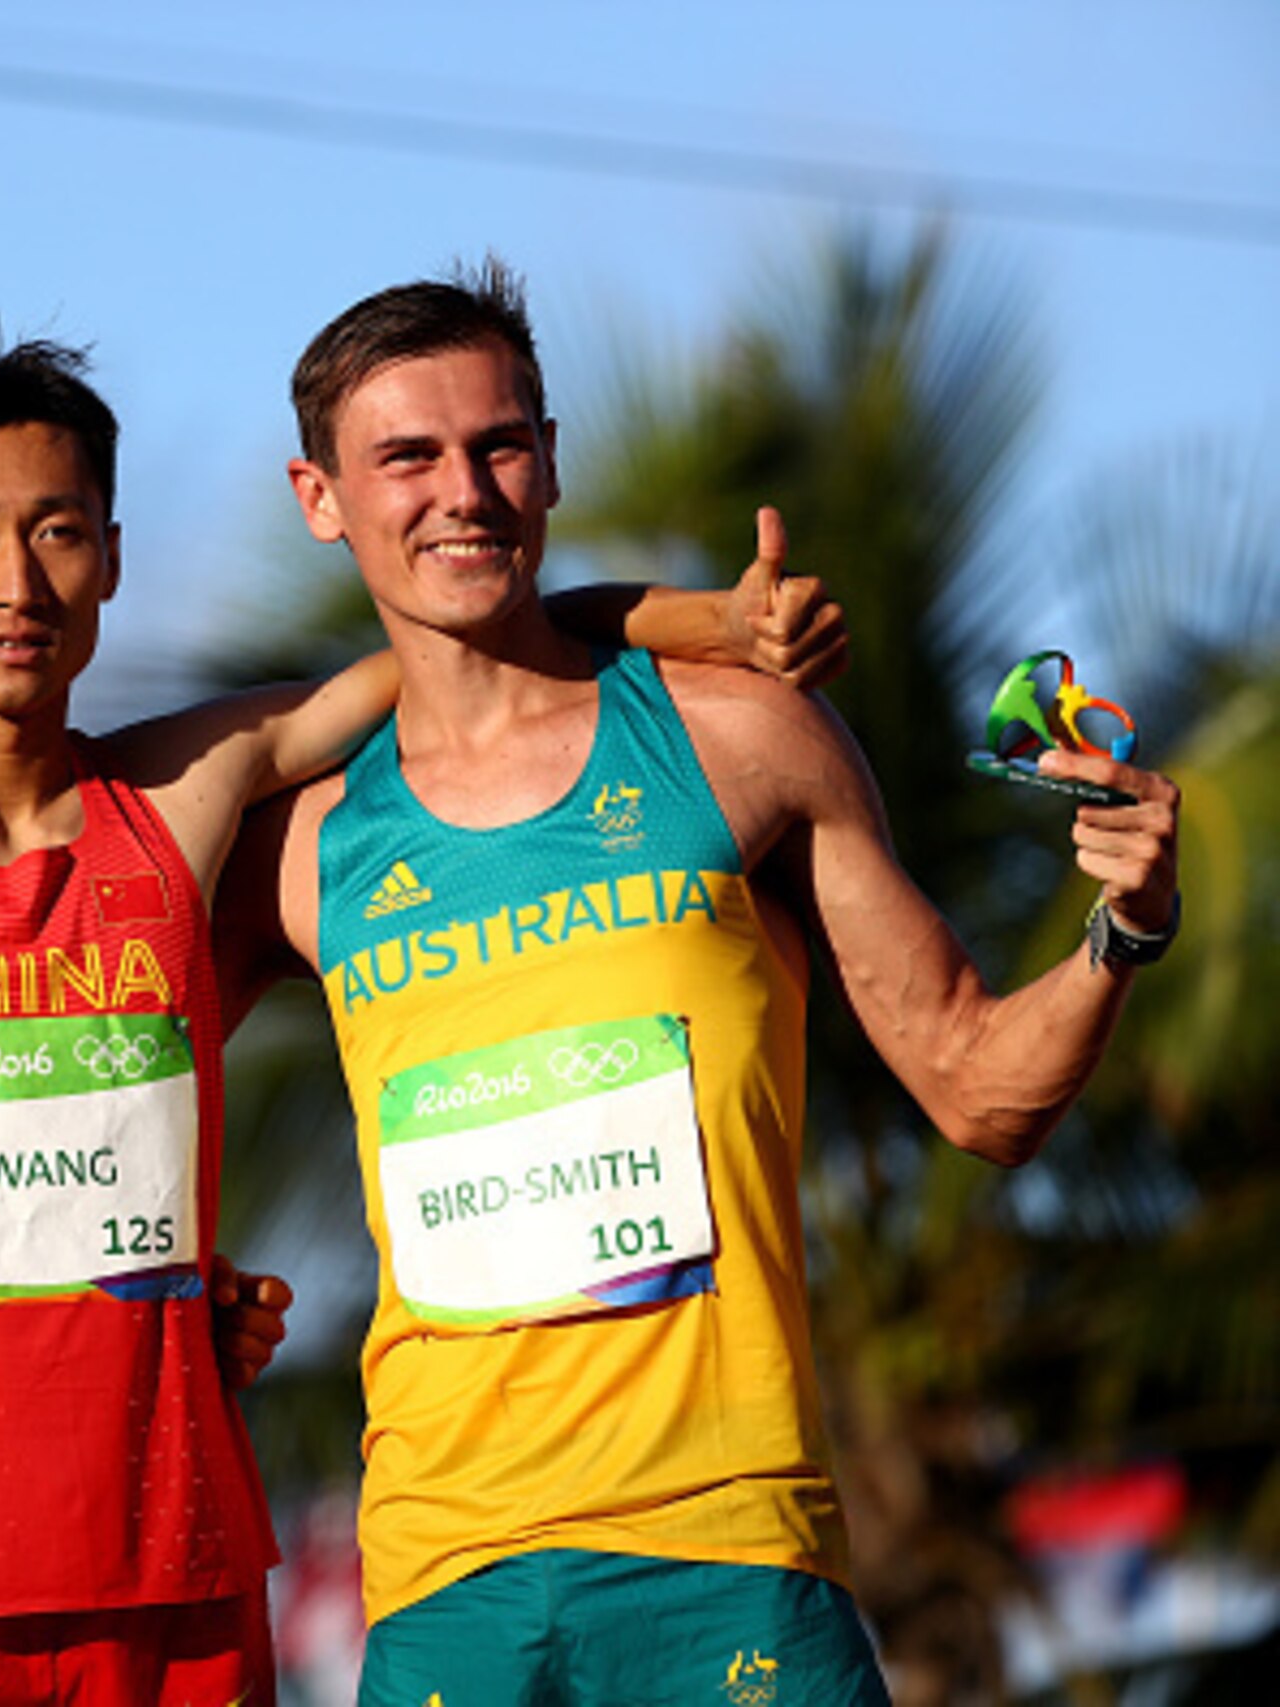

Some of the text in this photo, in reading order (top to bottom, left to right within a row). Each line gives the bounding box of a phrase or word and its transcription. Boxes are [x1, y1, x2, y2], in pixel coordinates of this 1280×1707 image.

[342, 870, 717, 1013] AUSTRALIA
[419, 1147, 661, 1229] BIRD-SMITH
[101, 1217, 175, 1256] 125
[588, 1216, 674, 1261] 101
